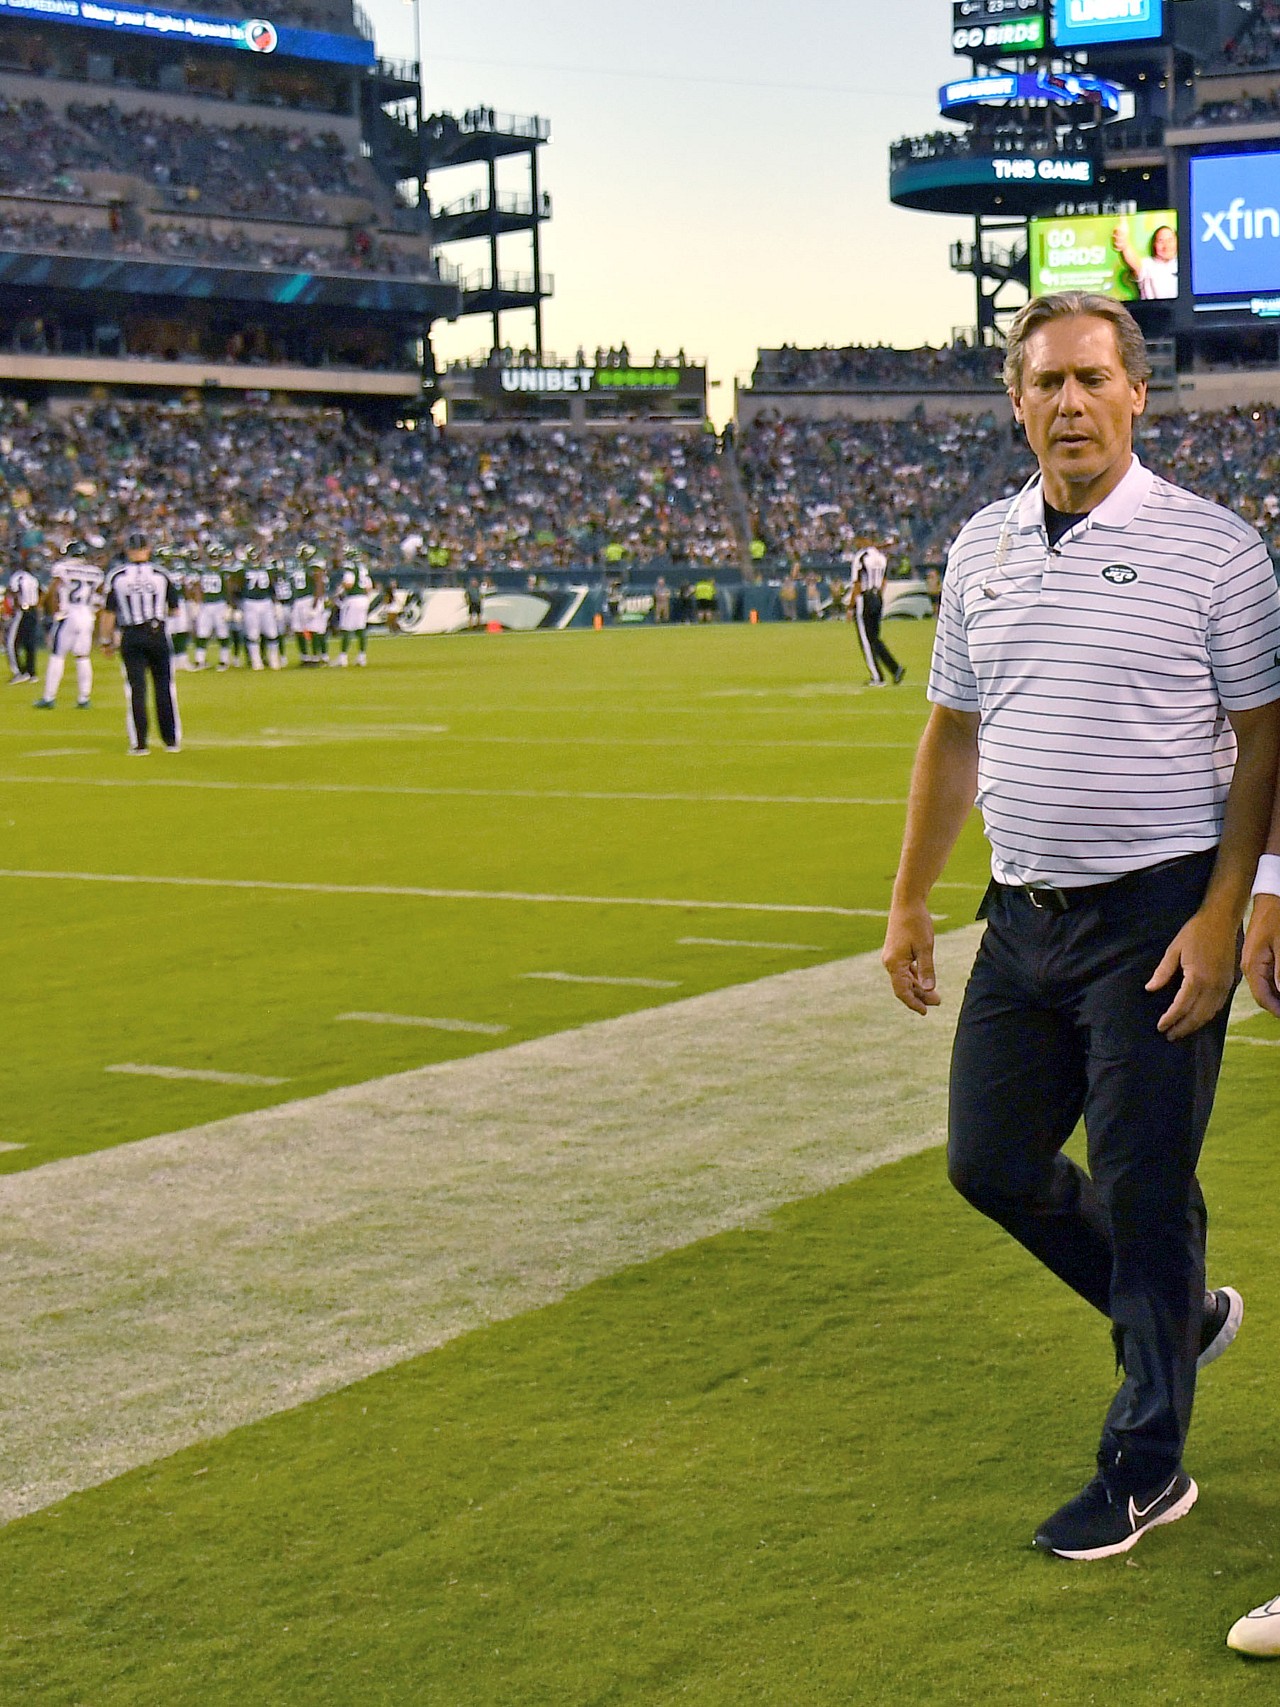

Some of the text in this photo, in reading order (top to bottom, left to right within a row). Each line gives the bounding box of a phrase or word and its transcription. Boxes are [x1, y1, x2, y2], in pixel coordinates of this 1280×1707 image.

[954, 23, 1040, 48] GO BIRDS
[992, 158, 1089, 181] THIS GAME
[1047, 229, 1076, 248] GO
[501, 368, 595, 391] UNIBET
